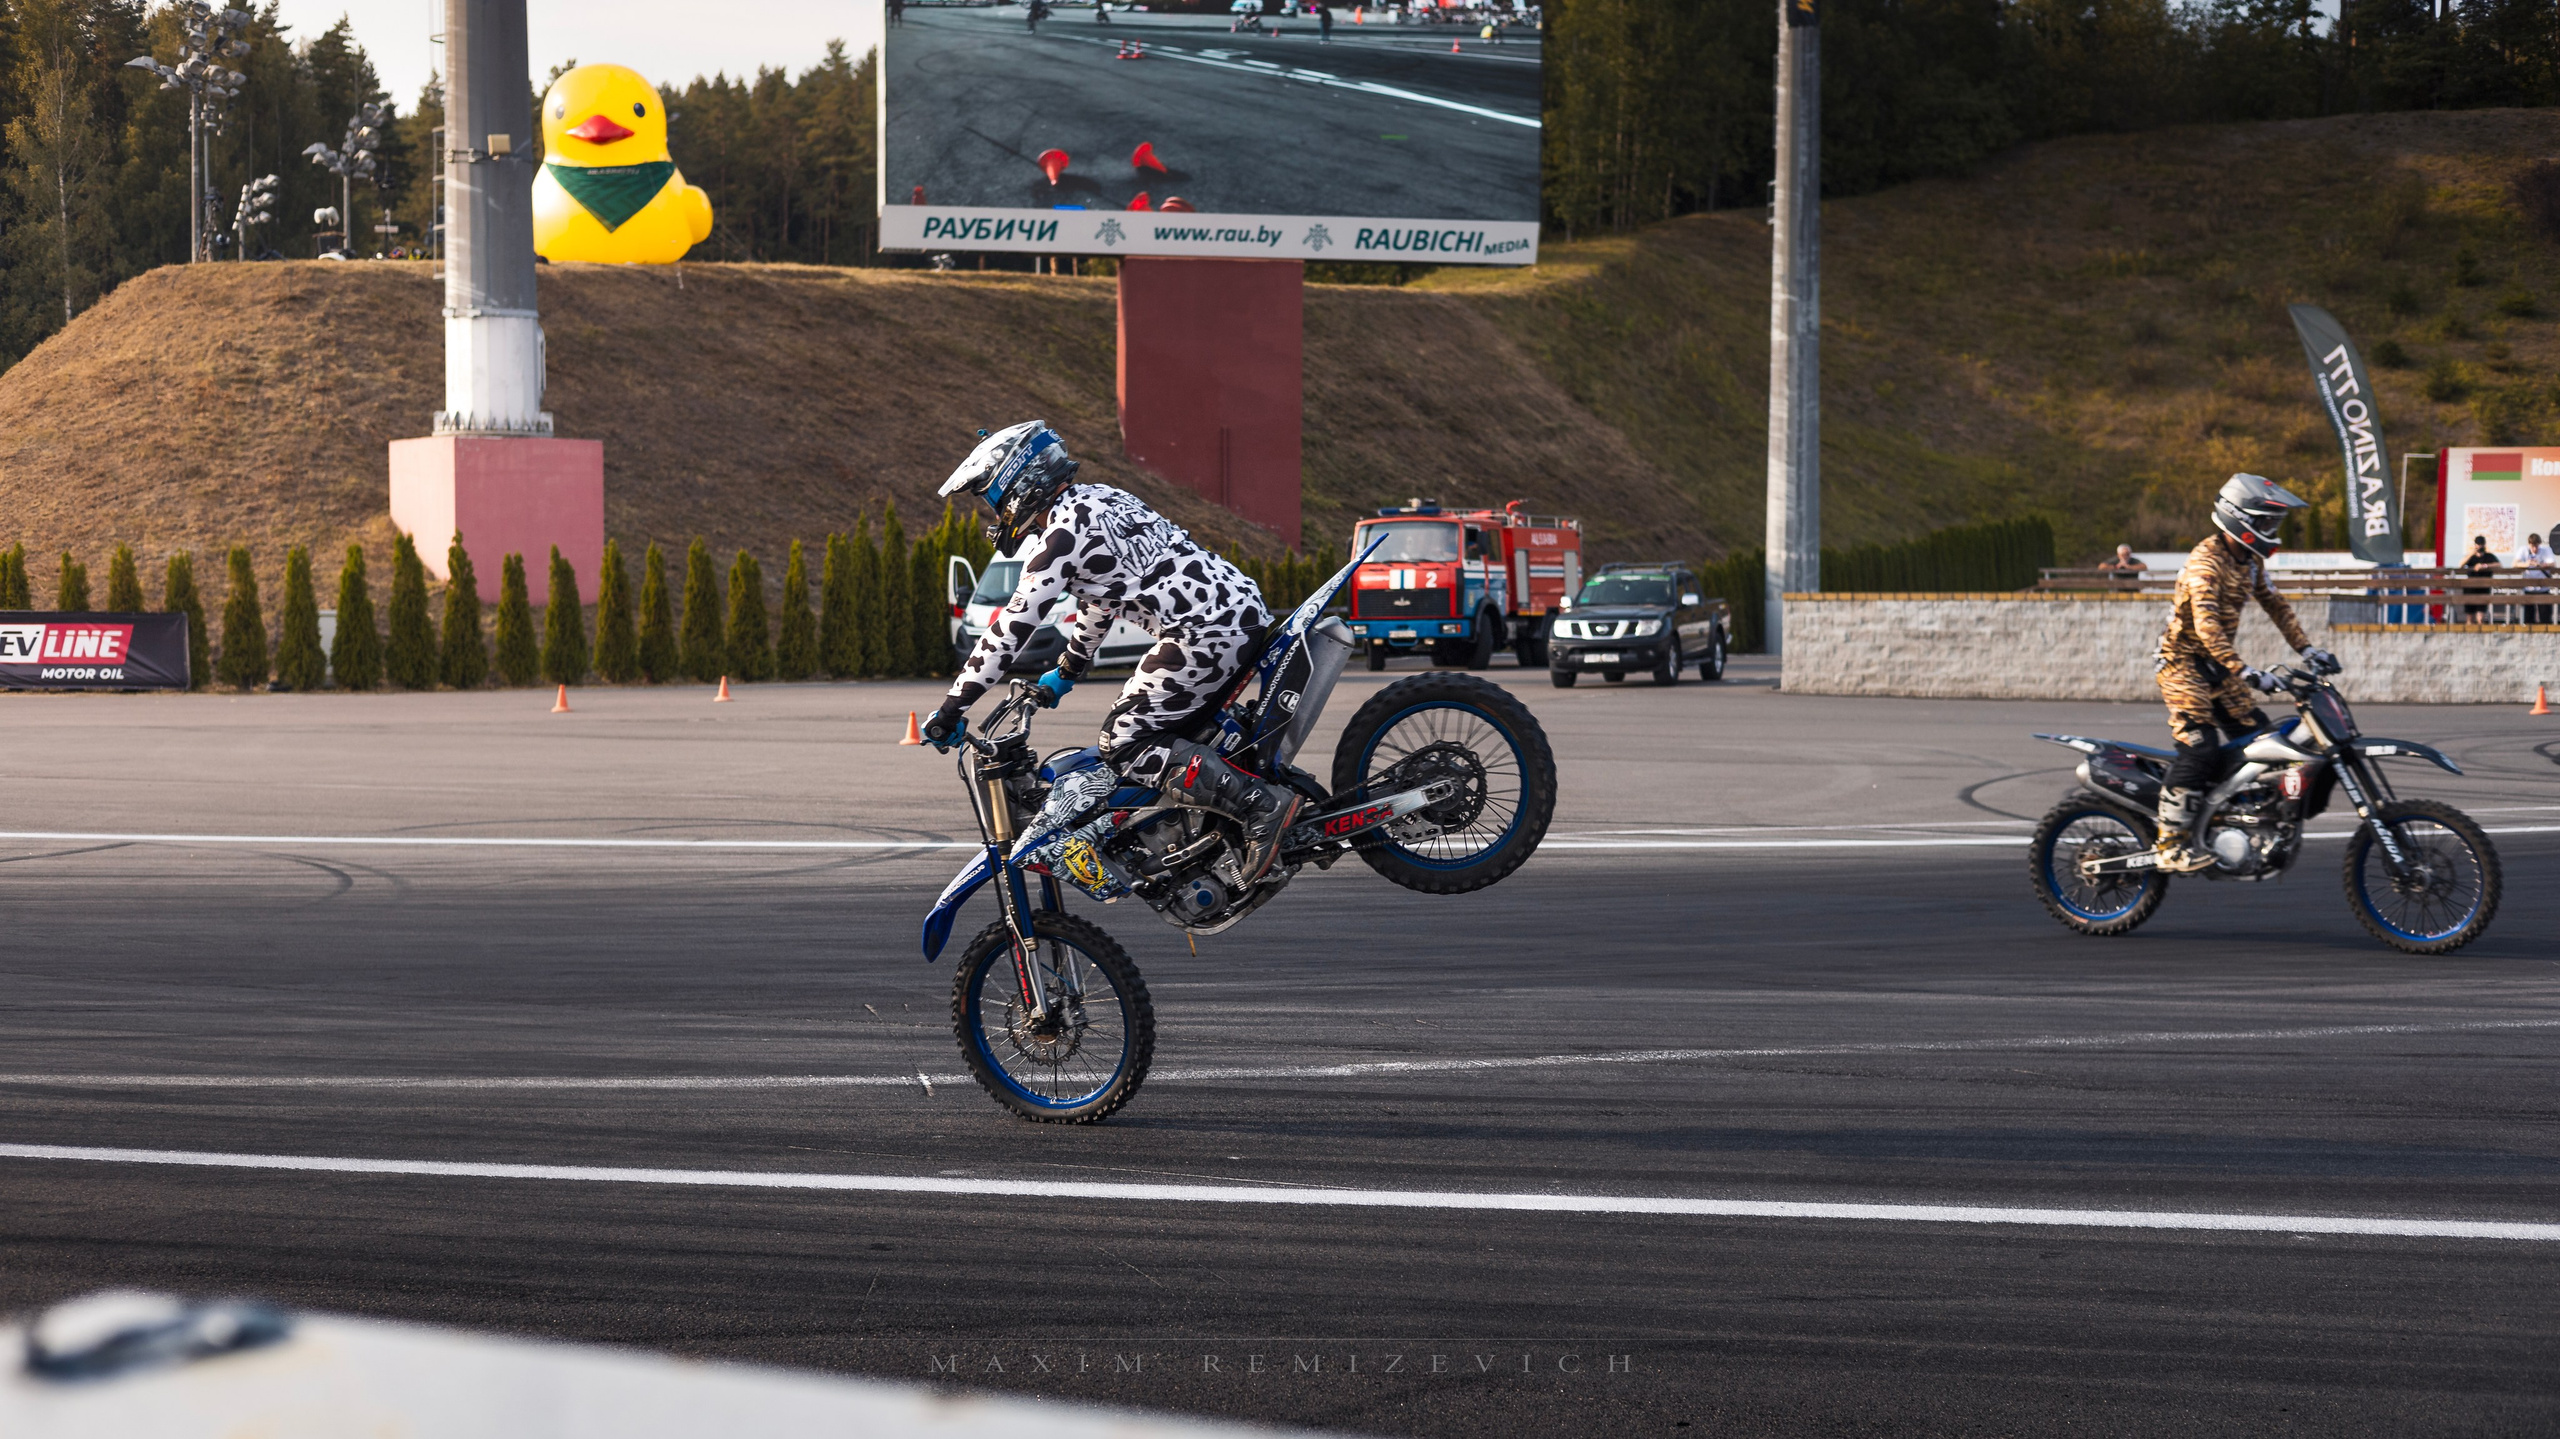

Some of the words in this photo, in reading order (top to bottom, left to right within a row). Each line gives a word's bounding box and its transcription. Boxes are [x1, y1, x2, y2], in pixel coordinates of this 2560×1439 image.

[922, 216, 1059, 242] РАУБИЧИ
[1153, 224, 1283, 248] www.rau.by
[1354, 227, 1485, 253] RAUBICHI
[1484, 238, 1530, 257] MEDIA
[998, 443, 1033, 491] SCOTT
[1425, 571, 1438, 588] 2
[41, 668, 95, 680] MOTOR
[99, 668, 124, 680] OIL
[2371, 818, 2404, 863] KENDA
